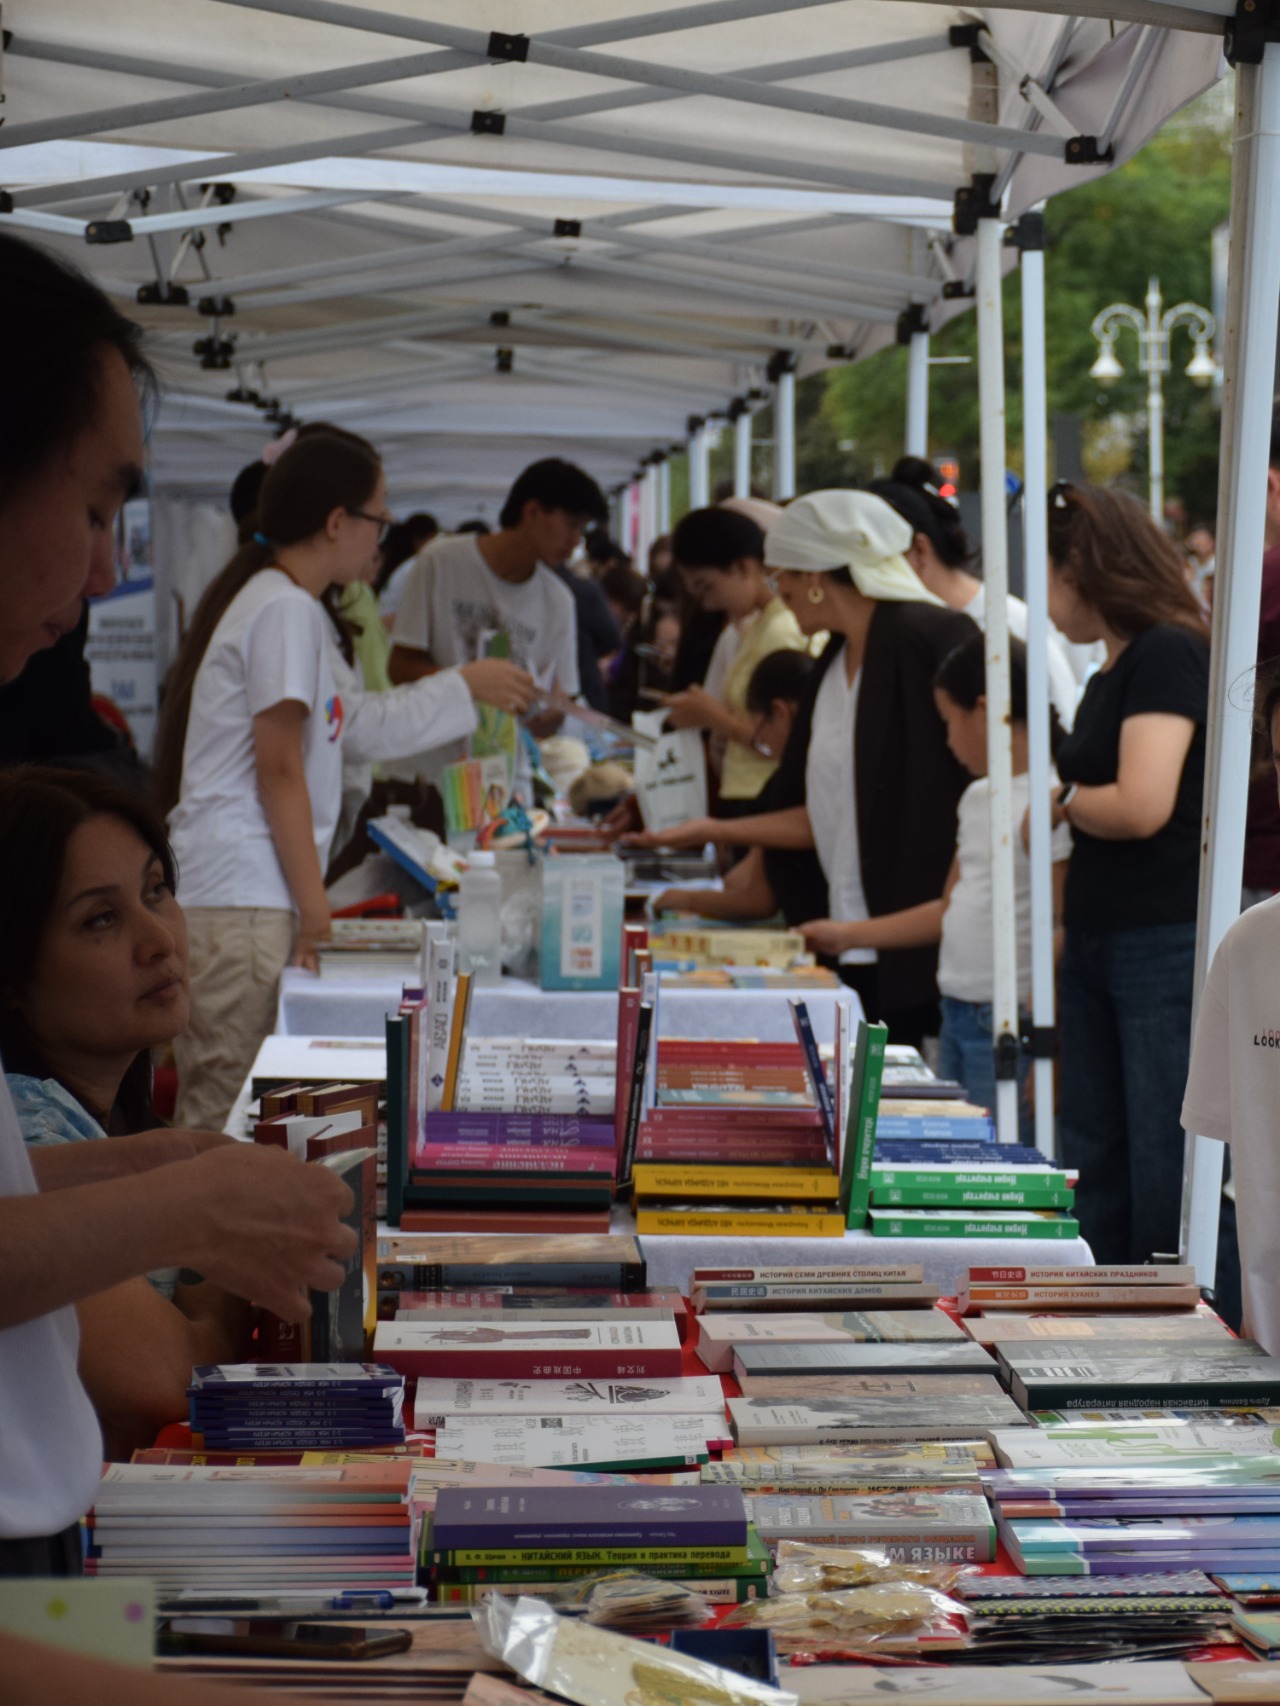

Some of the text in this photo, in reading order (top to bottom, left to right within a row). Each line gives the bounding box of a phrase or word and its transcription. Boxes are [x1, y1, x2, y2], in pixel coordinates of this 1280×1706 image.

[794, 1271, 814, 1279] СЕМИ
[815, 1271, 851, 1279] ДРЕВНИХ
[852, 1270, 882, 1279] СТОЛИЦ
[1066, 1270, 1108, 1278] КИТАЙСКИХ
[1110, 1271, 1158, 1279] ПРАЗДНИКОВ
[808, 1286, 853, 1295] КИТАЙСКИХ
[854, 1287, 882, 1295] ДОМОВ
[532, 1365, 582, 1375] 中国戏曲史
[616, 1365, 645, 1375] 刘文峰
[1066, 1398, 1209, 1409] Китайская народная литература
[838, 1535, 866, 1544] КУРС
[868, 1535, 920, 1544] РЕЧЕВОГО
[923, 1535, 976, 1544] ОБЩЕНИЯ
[521, 1549, 574, 1561] КИТАЙСКИЙ
[575, 1550, 604, 1561] ЯЗЫК.
[607, 1550, 638, 1561] Теория
[648, 1551, 687, 1561] практика
[690, 1550, 731, 1560] перевода
[910, 1546, 976, 1561] ЯЗЫКЕ
